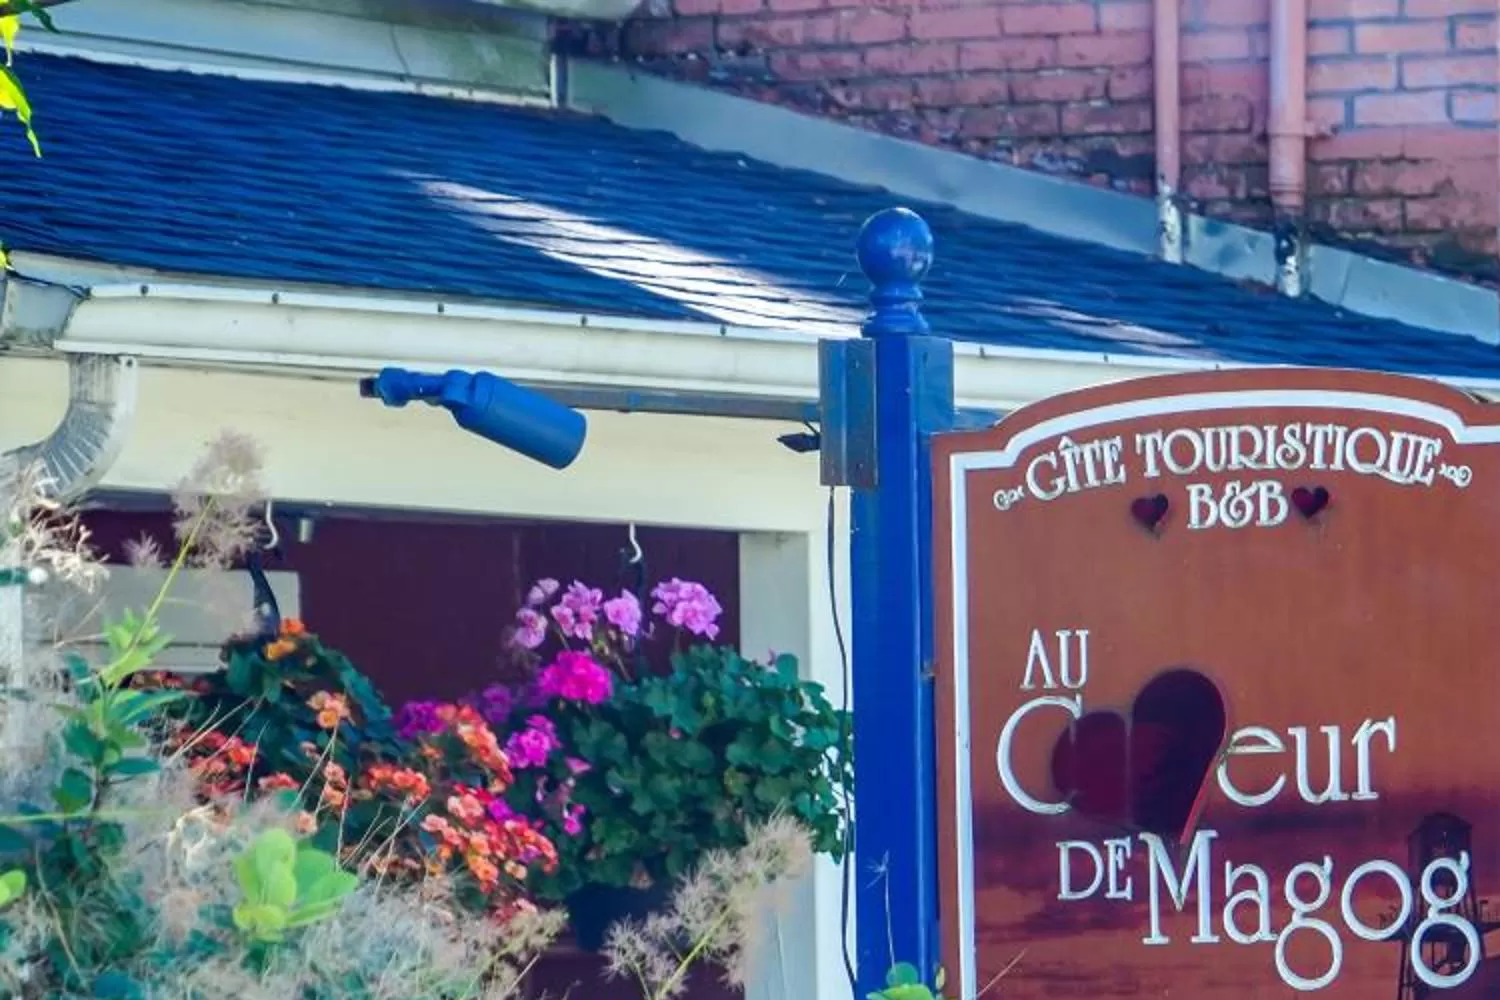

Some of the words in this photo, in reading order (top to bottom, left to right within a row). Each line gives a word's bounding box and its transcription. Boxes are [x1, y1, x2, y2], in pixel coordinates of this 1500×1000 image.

[1026, 436, 1126, 501] GÎTE
[1136, 422, 1443, 486] TOURISTIQUE
[1186, 480, 1290, 529] B&B
[1020, 629, 1091, 690] AU
[1056, 837, 1133, 901] DE
[1139, 829, 1480, 991] Magog
